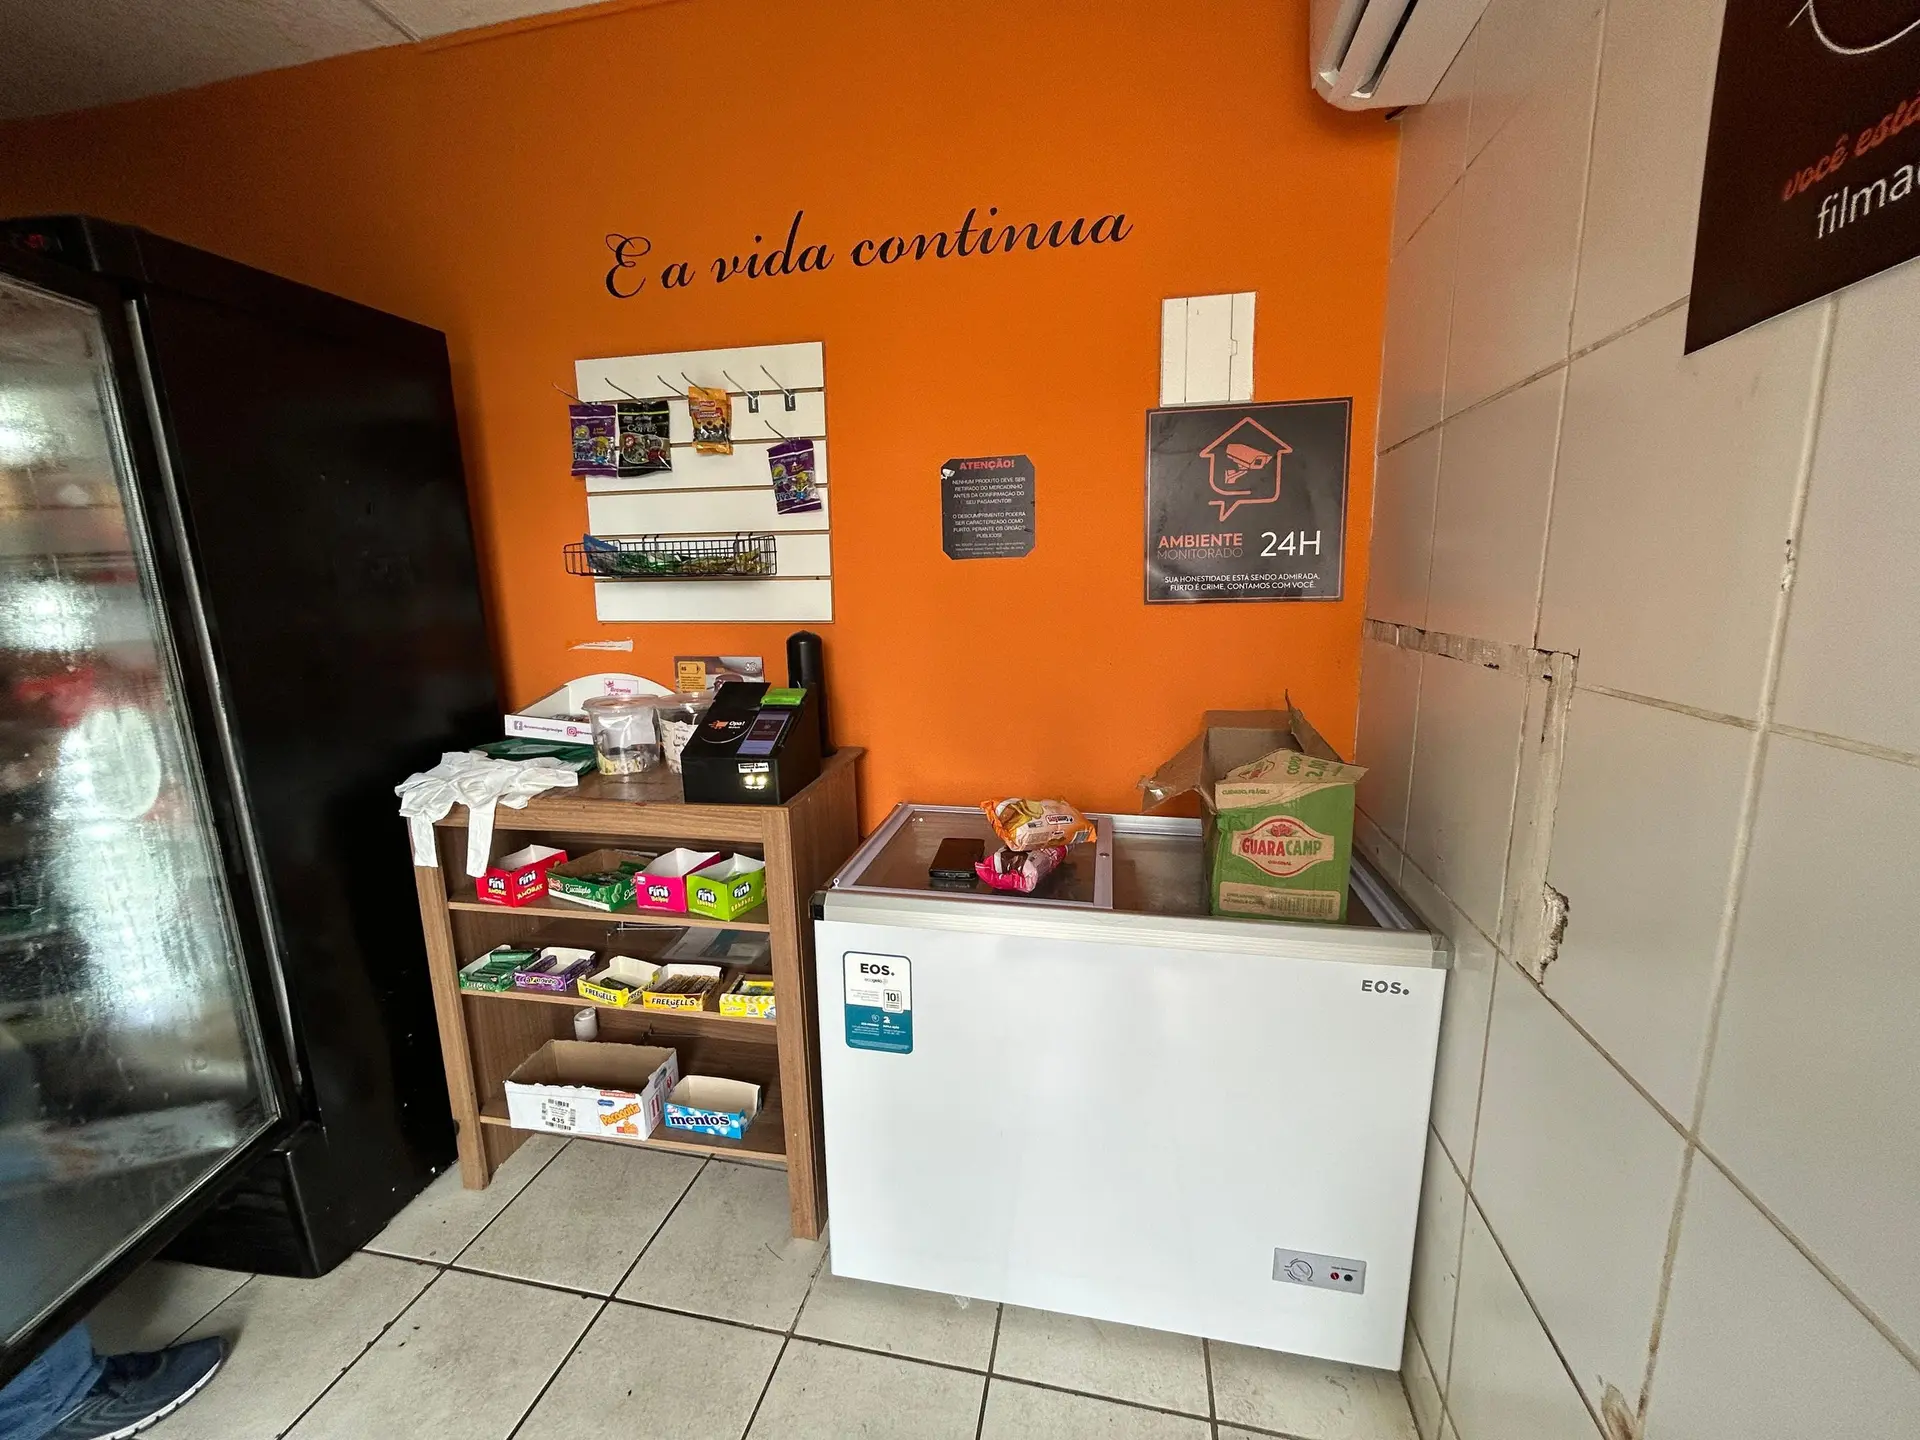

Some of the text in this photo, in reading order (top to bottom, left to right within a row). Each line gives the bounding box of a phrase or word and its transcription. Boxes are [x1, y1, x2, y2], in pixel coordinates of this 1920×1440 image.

[1782, 133, 1849, 201] você
[1818, 163, 1920, 239] filma
[605, 206, 1134, 299] E a vida continua
[960, 458, 1015, 470] ATENÇÃO!
[1158, 533, 1243, 549] AMBIENTE
[1260, 530, 1321, 557] 24H
[1157, 547, 1244, 561] MONITORADO
[1180, 575, 1231, 583] HONESTIDADE
[1232, 573, 1250, 582] ESTÁ
[1250, 573, 1277, 581] SENDO
[1279, 572, 1320, 581] ADMIRADA.
[1170, 584, 1194, 592] FURTO
[1195, 582, 1200, 590] É
[1226, 582, 1271, 590] CONTAMOS
[1271, 581, 1291, 589] COM
[1242, 838, 1322, 857] GUARACAMP
[488, 877, 505, 889] Fini
[519, 870, 536, 884] Fini
[565, 883, 591, 894] Eucalipto
[648, 885, 669, 897] Fini
[734, 882, 750, 897] Fini
[698, 889, 715, 903] Fini
[585, 987, 618, 1003] FREEGELLS
[651, 997, 695, 1007] FREEGELLS
[886, 992, 896, 1002] 10
[669, 1114, 729, 1126] mentos
